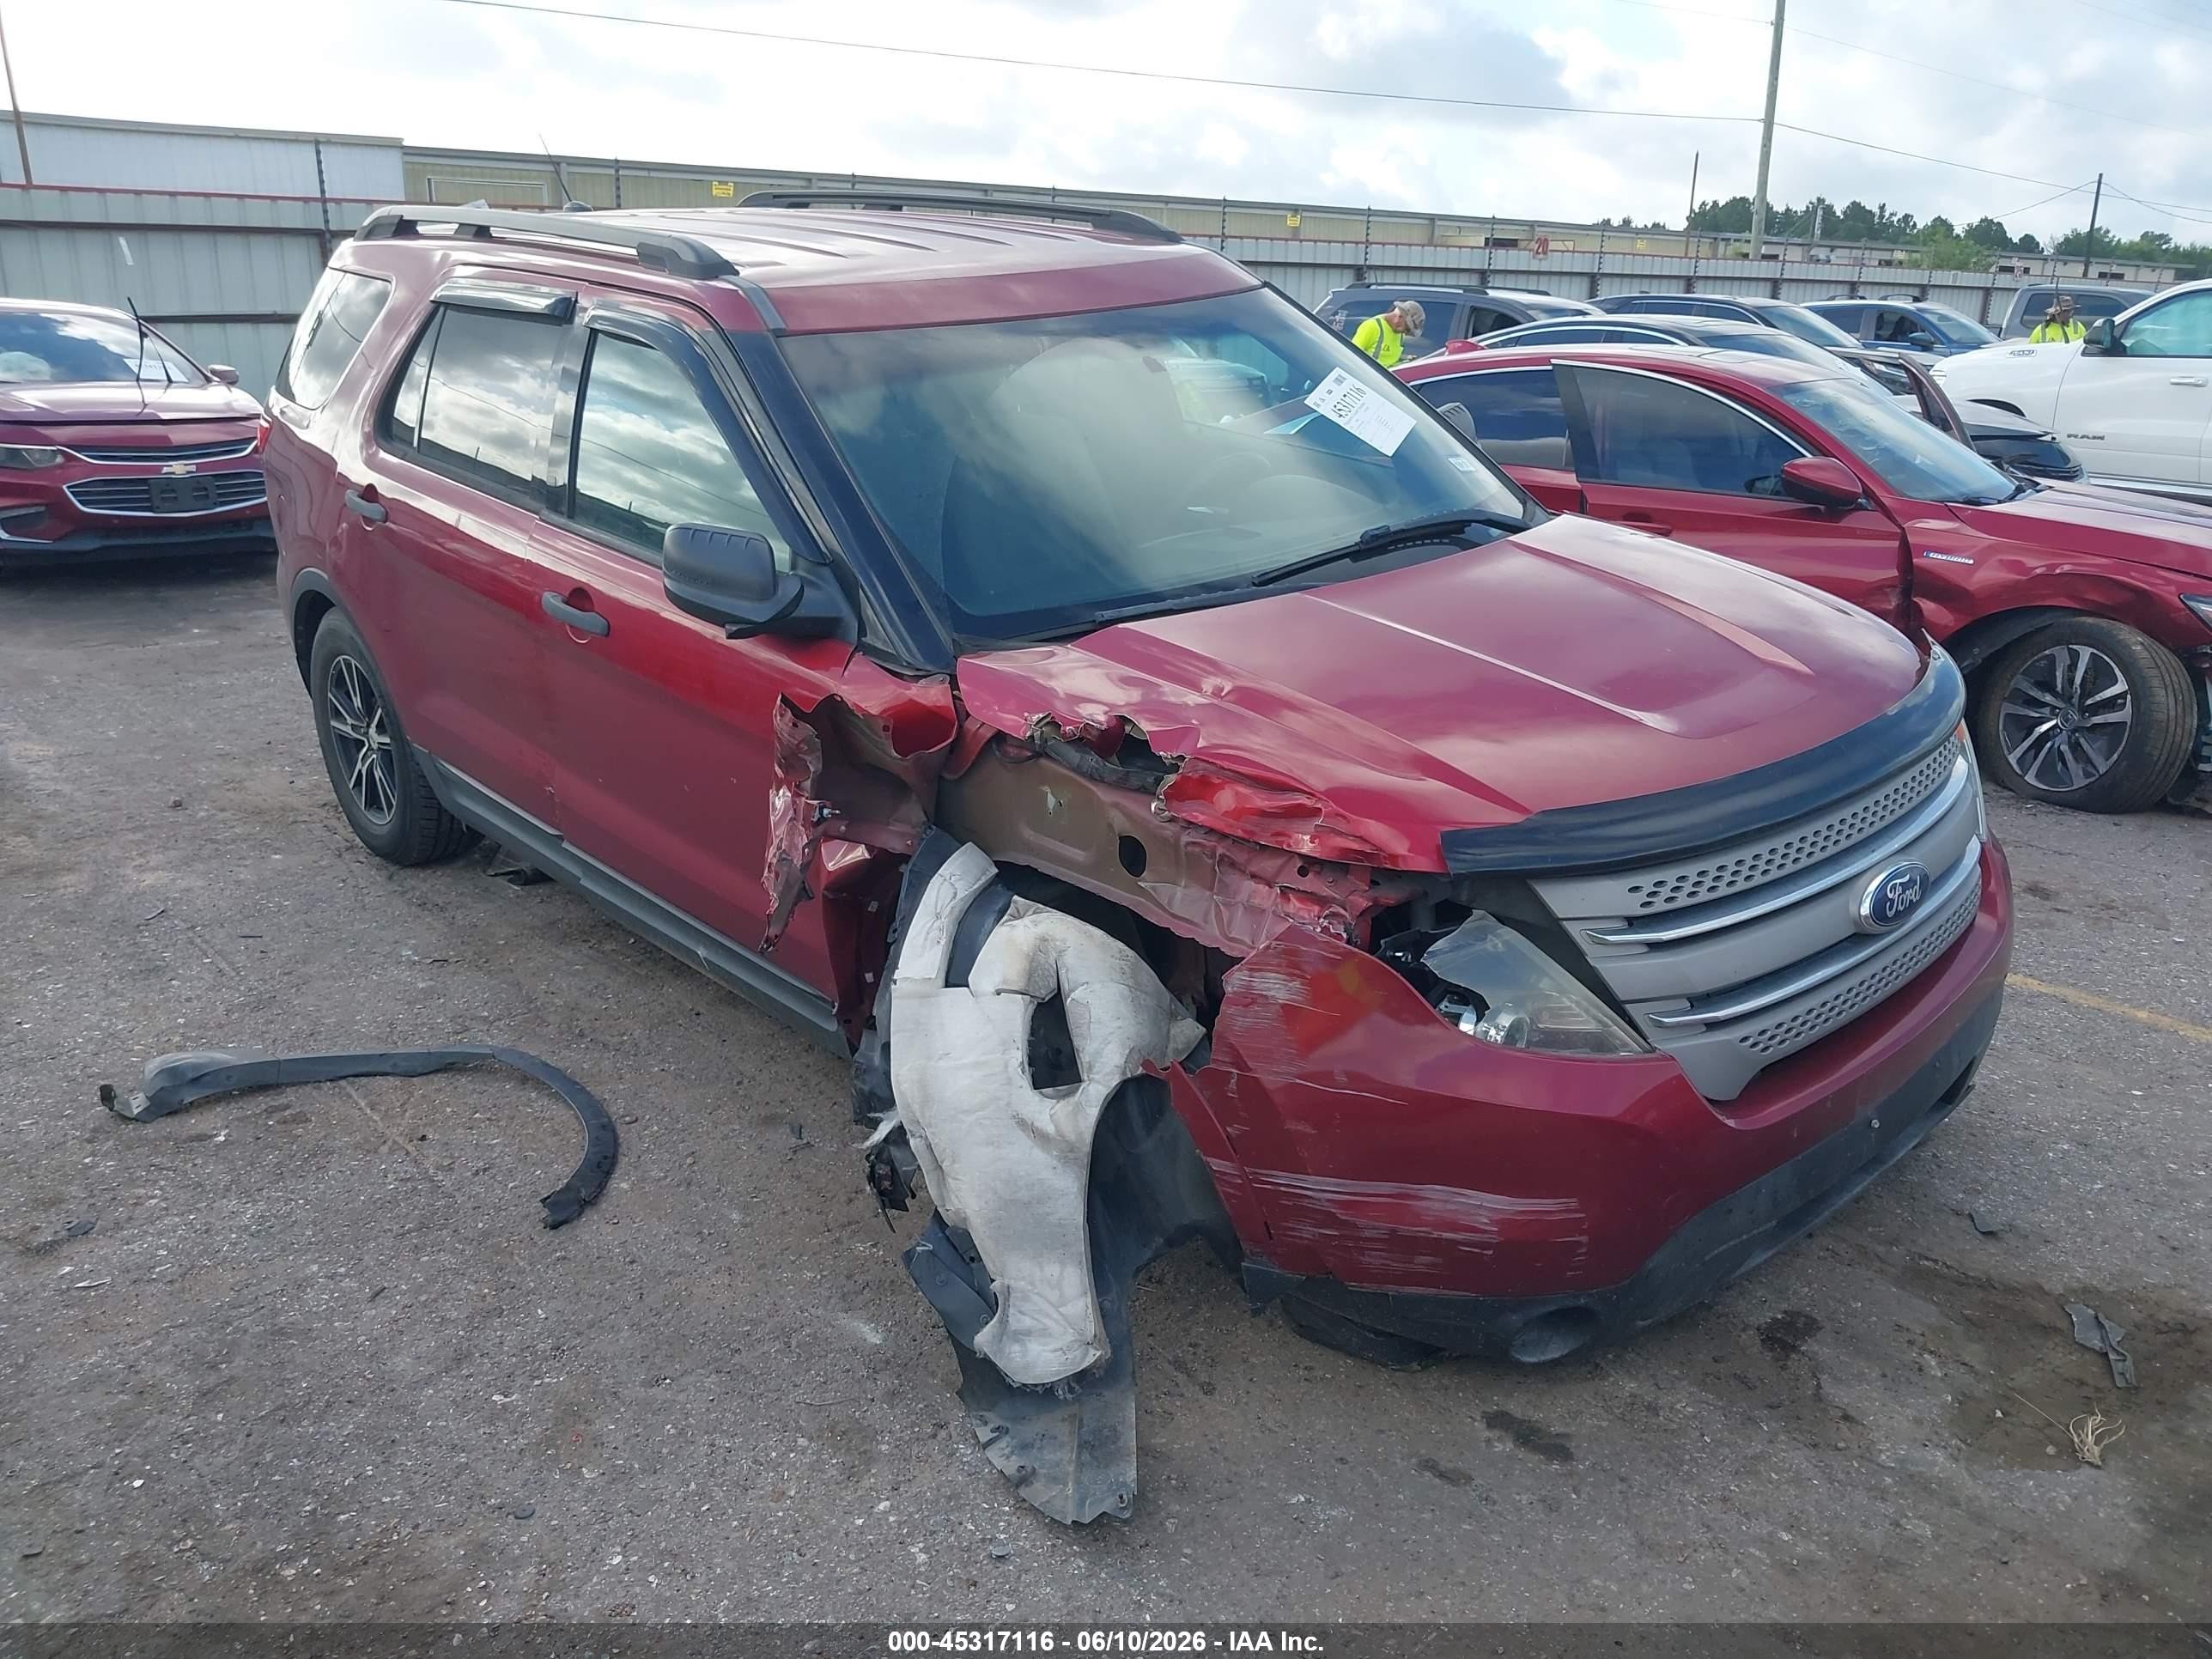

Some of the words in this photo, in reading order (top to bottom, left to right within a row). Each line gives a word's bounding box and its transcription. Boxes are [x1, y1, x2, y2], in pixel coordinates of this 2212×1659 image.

[1534, 237, 1550, 256] 20
[1331, 384, 1367, 419] 45317116
[1886, 873, 1922, 918] Ford
